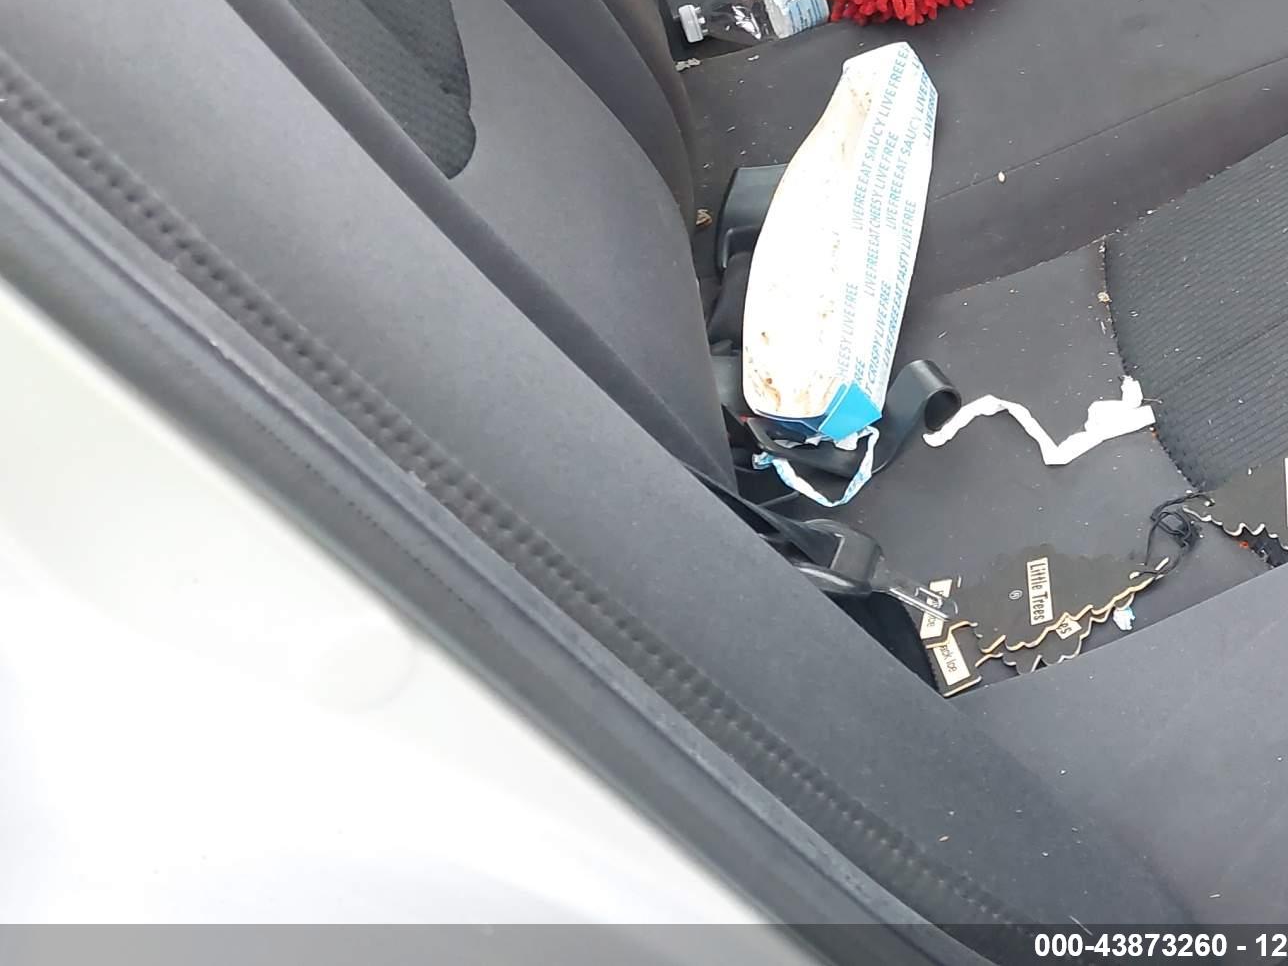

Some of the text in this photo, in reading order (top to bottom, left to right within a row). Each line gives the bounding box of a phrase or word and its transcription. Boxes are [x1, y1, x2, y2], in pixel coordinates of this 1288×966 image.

[888, 58, 907, 89] FREE
[878, 88, 897, 118] LIVE
[915, 84, 929, 115] LIVE
[864, 117, 886, 162] SAUCY
[858, 161, 872, 185] EAT
[894, 156, 908, 181] EAT
[853, 183, 868, 211] FREE
[888, 179, 904, 208] FREE
[863, 131, 900, 298] LIVE FREE EAT CHEESY LIVE FREE
[885, 206, 898, 231] LIVE
[902, 200, 917, 227] FREE
[901, 226, 913, 251] LIVE
[897, 248, 910, 285] TASTY
[843, 282, 859, 310] FREE
[879, 280, 892, 311] FREE
[874, 308, 888, 339] LIVE
[835, 335, 852, 379] HEESY
[855, 356, 866, 381] REE
[867, 336, 882, 384] CRISPY
[1030, 562, 1048, 626] Little Trees
